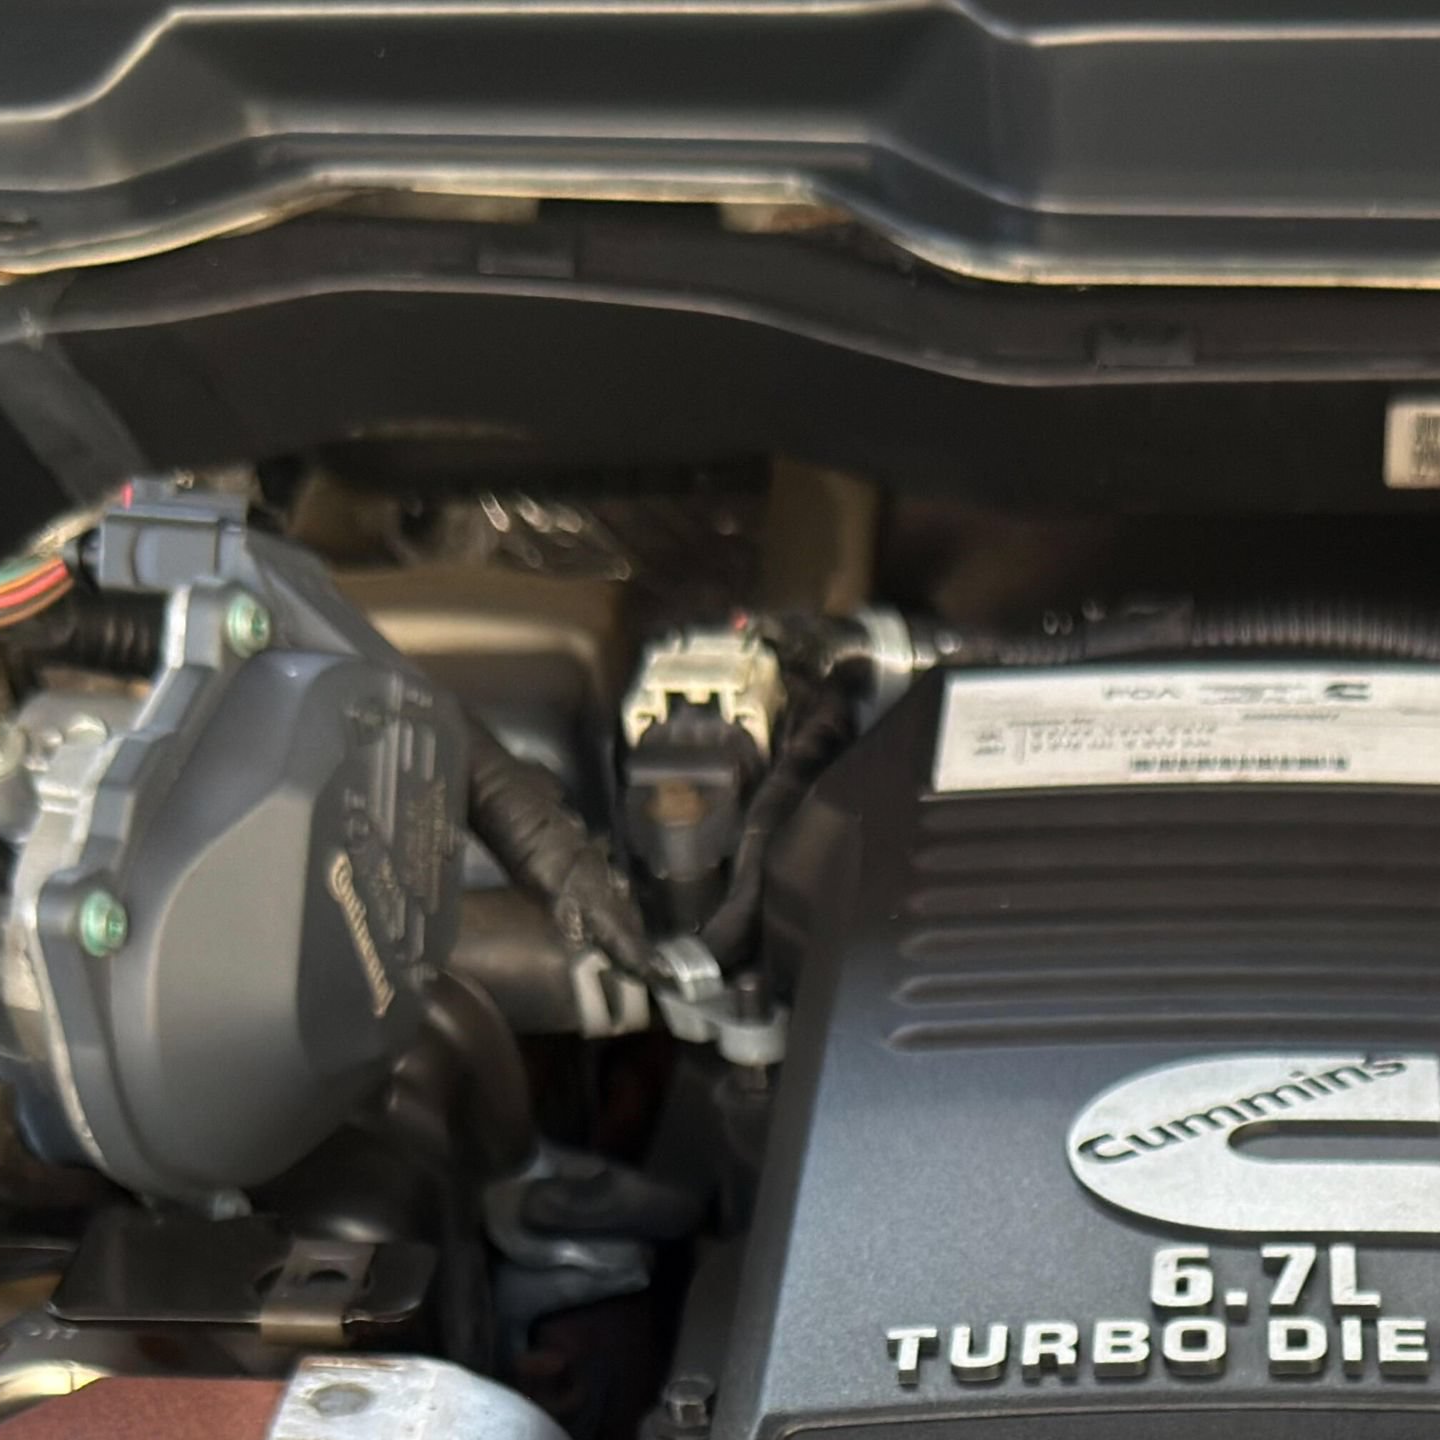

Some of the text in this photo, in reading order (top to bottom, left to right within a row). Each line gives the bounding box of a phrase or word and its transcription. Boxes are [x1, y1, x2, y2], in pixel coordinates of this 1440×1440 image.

[1076, 1052, 1410, 1168] Cummins
[1148, 1243, 1383, 1315] 6.7L
[886, 1318, 1229, 1385] TURBO
